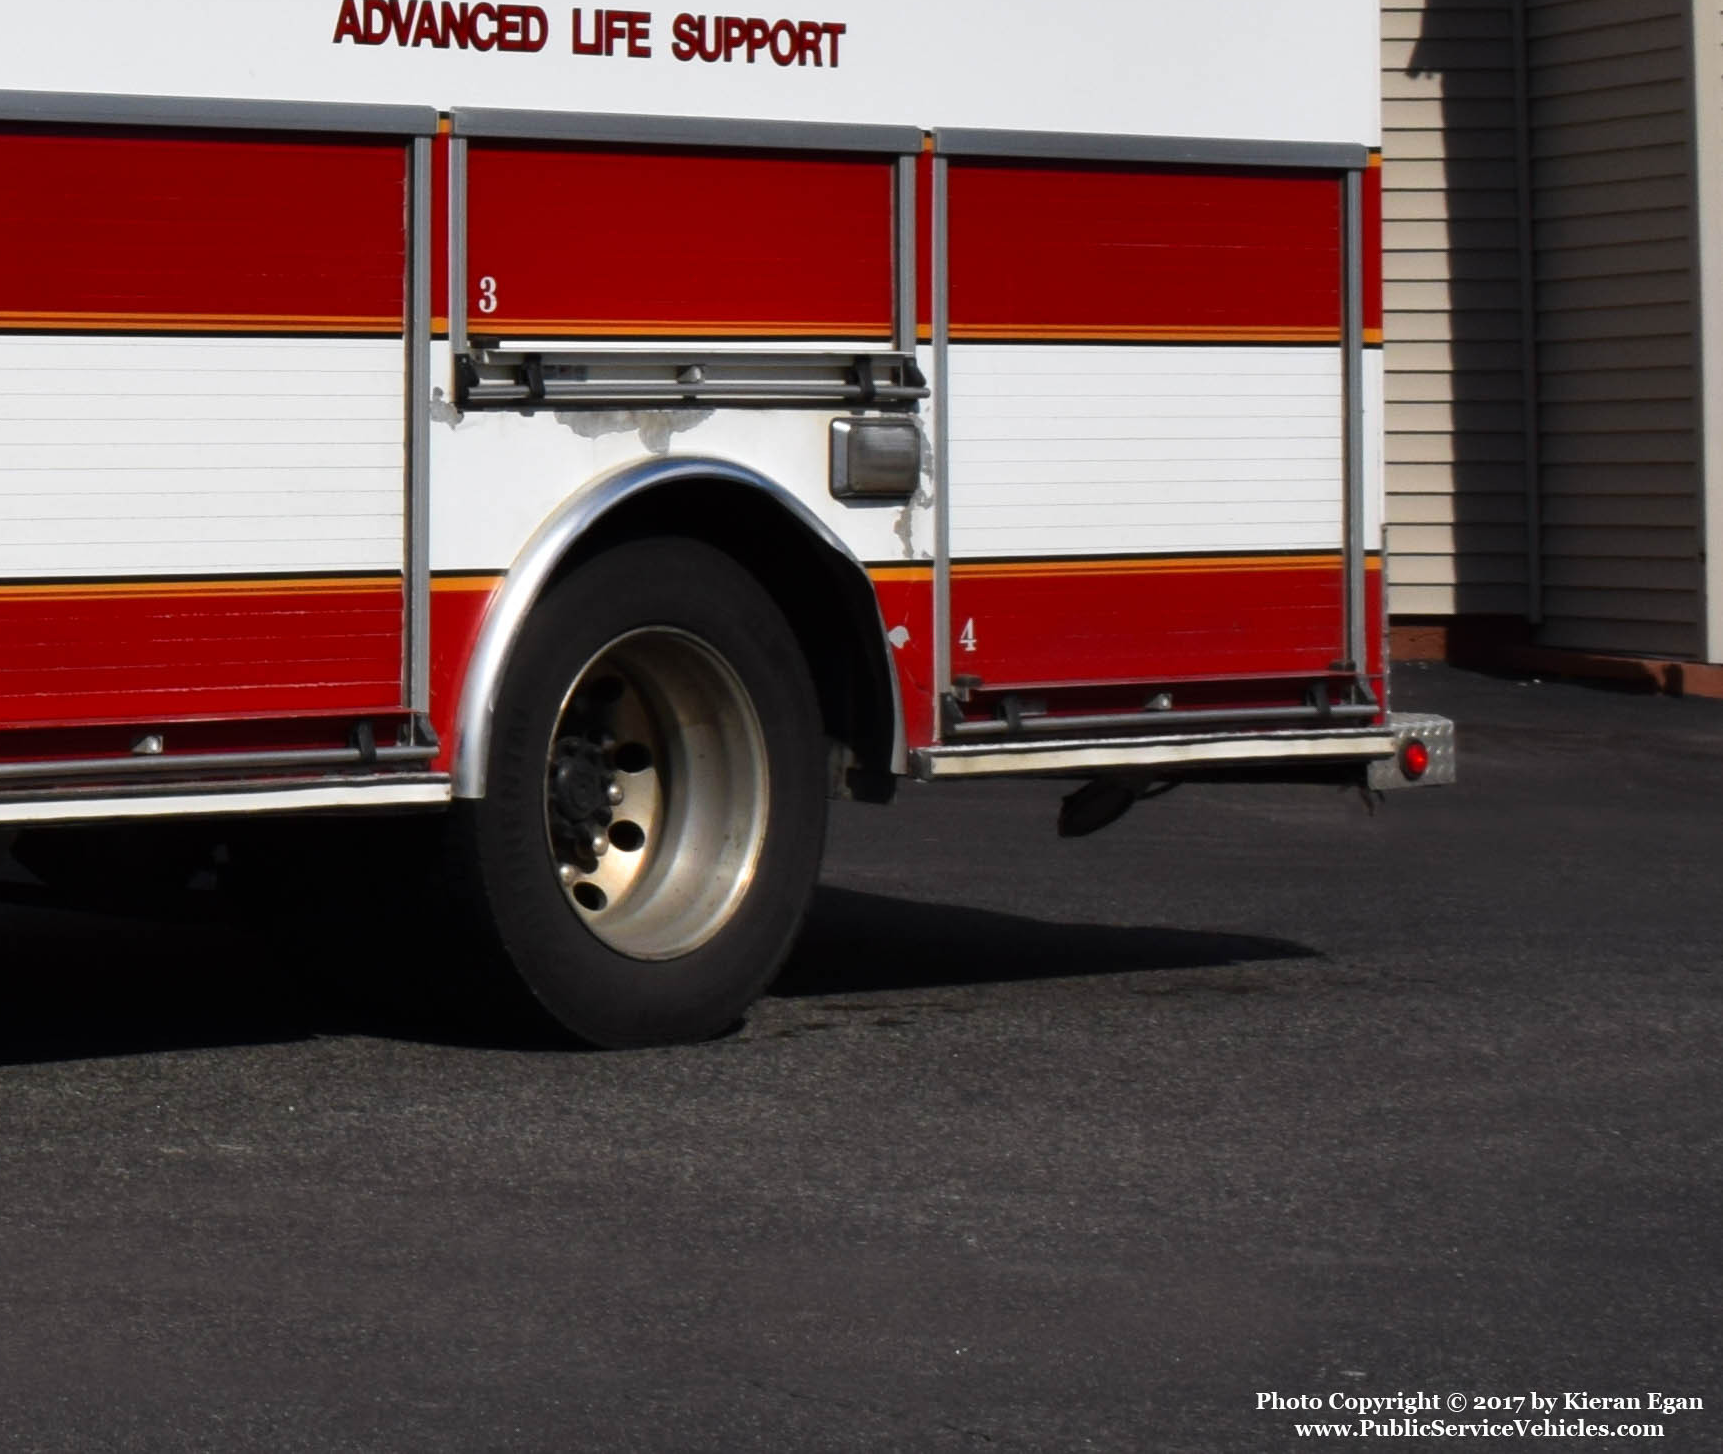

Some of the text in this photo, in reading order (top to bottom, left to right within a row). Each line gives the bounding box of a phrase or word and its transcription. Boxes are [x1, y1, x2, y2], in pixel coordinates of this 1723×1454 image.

[571, 7, 652, 58] LIFE
[671, 12, 847, 68] SUPPORT
[479, 277, 498, 312] 3
[960, 618, 977, 651] 4
